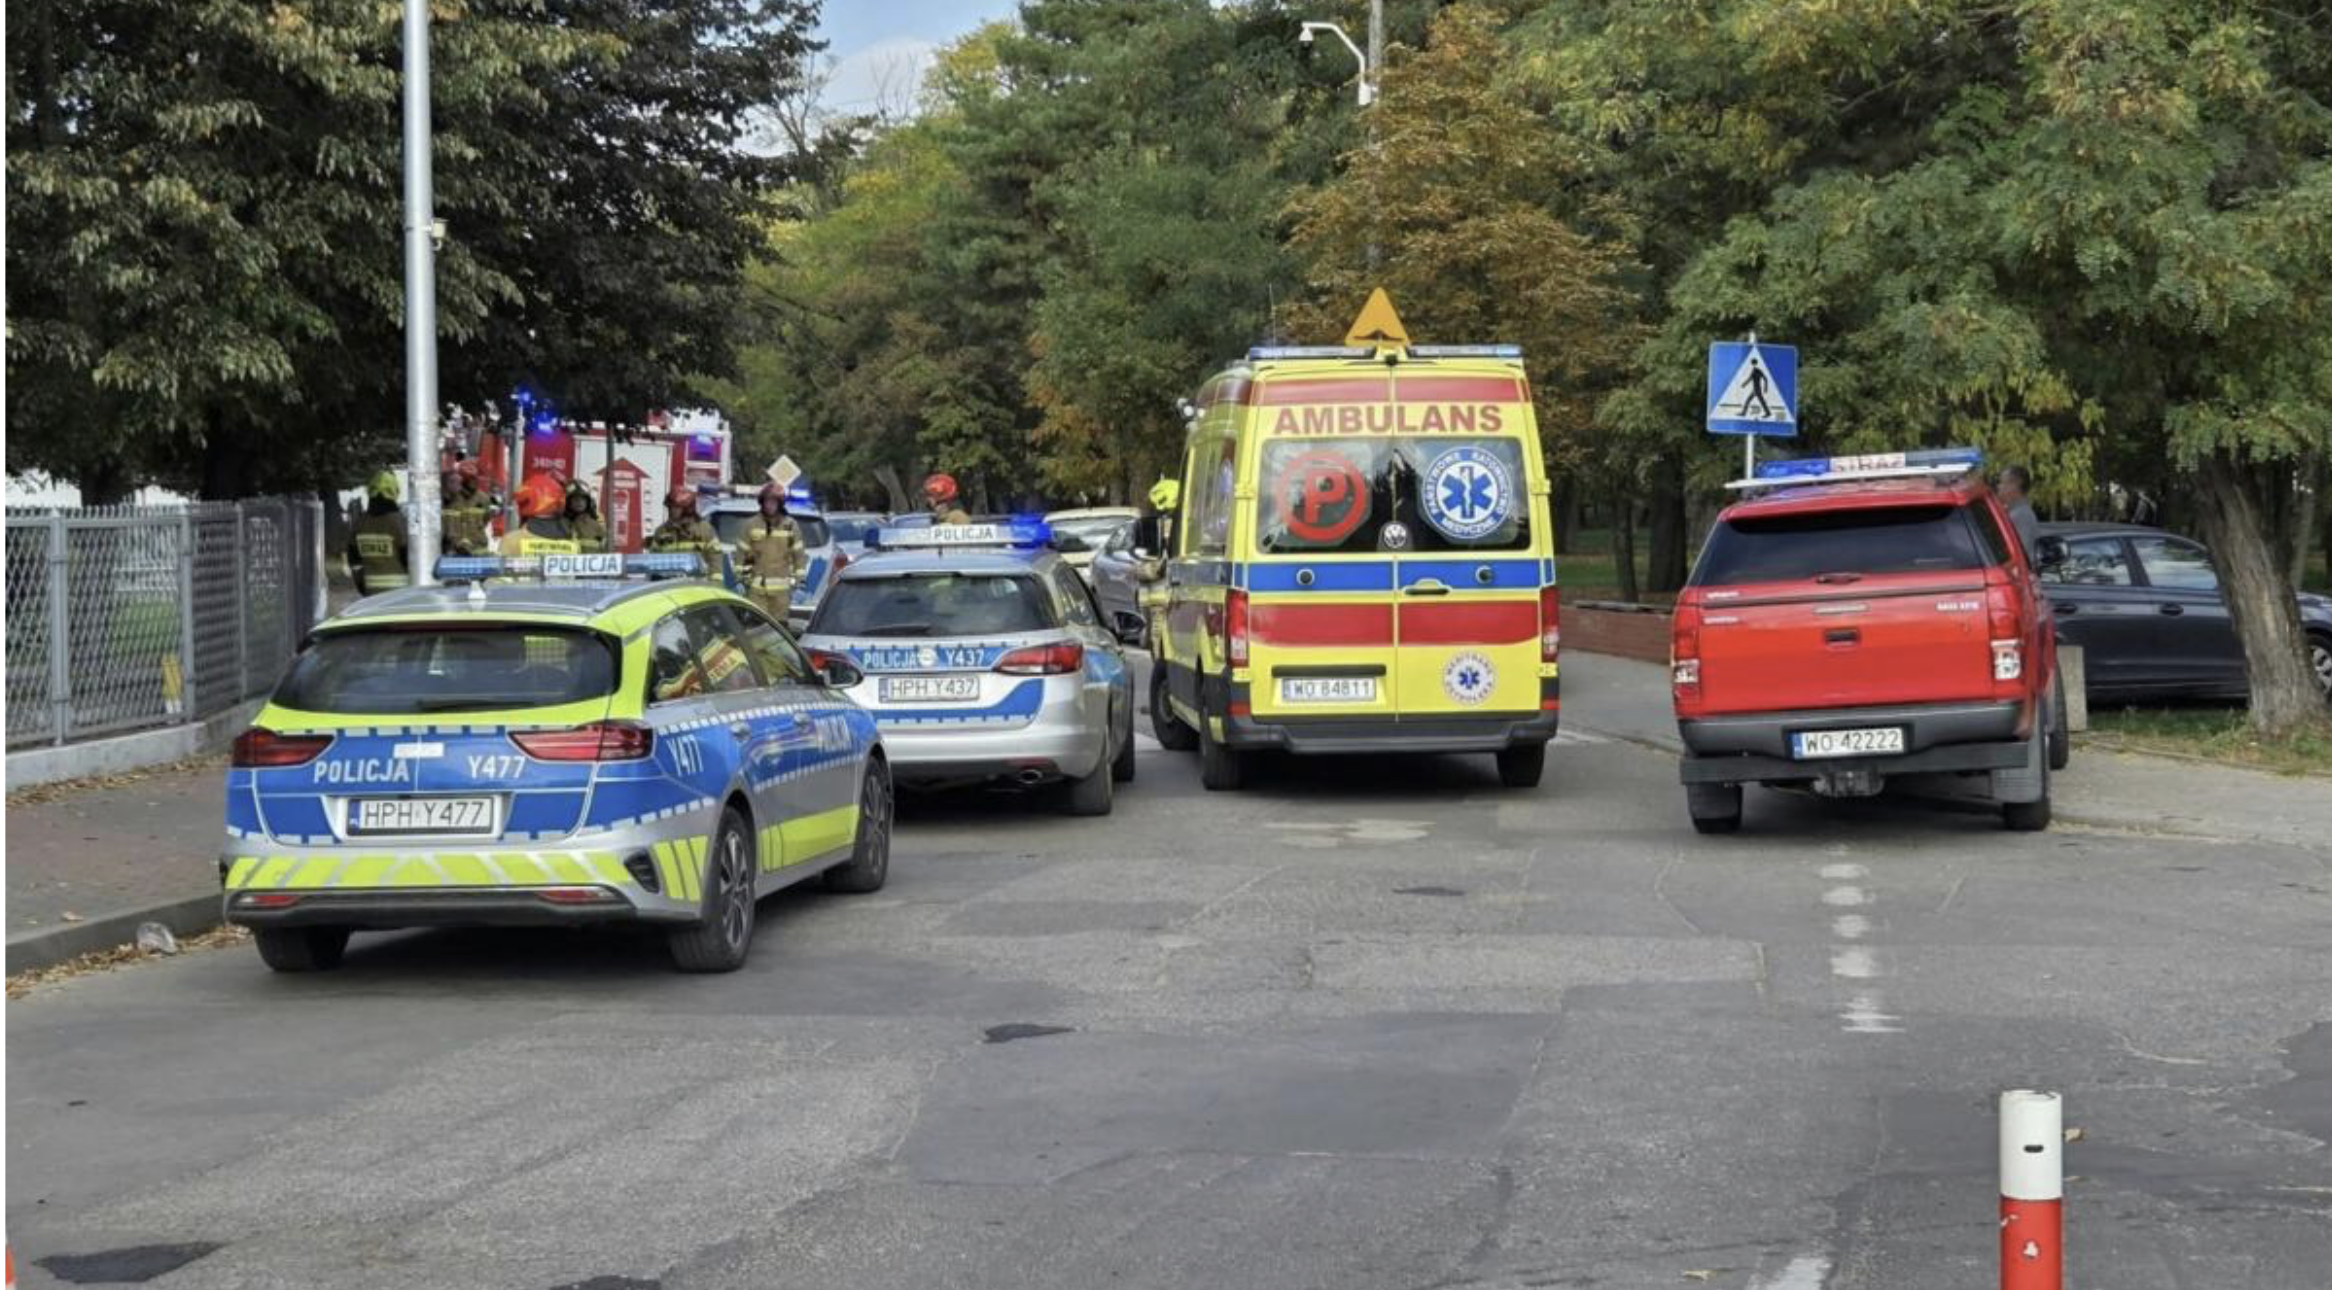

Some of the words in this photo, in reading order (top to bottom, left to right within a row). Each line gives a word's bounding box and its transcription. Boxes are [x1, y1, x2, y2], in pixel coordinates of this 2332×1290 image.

[1273, 405, 1503, 434] AMBULANS
[934, 528, 993, 540] POLICJA
[547, 556, 619, 573] POLICJA
[863, 651, 917, 669] POLICJA
[946, 650, 985, 668] Y437
[891, 679, 928, 695] HPH
[931, 678, 975, 695] Y437
[1294, 681, 1315, 695] WO
[1806, 734, 1833, 753] WO
[1841, 730, 1899, 750] 42222
[667, 734, 703, 777] Y477
[314, 757, 410, 783] POLICJA
[468, 756, 527, 780] Y477
[365, 802, 412, 826] HPH
[424, 801, 484, 826] Y477
